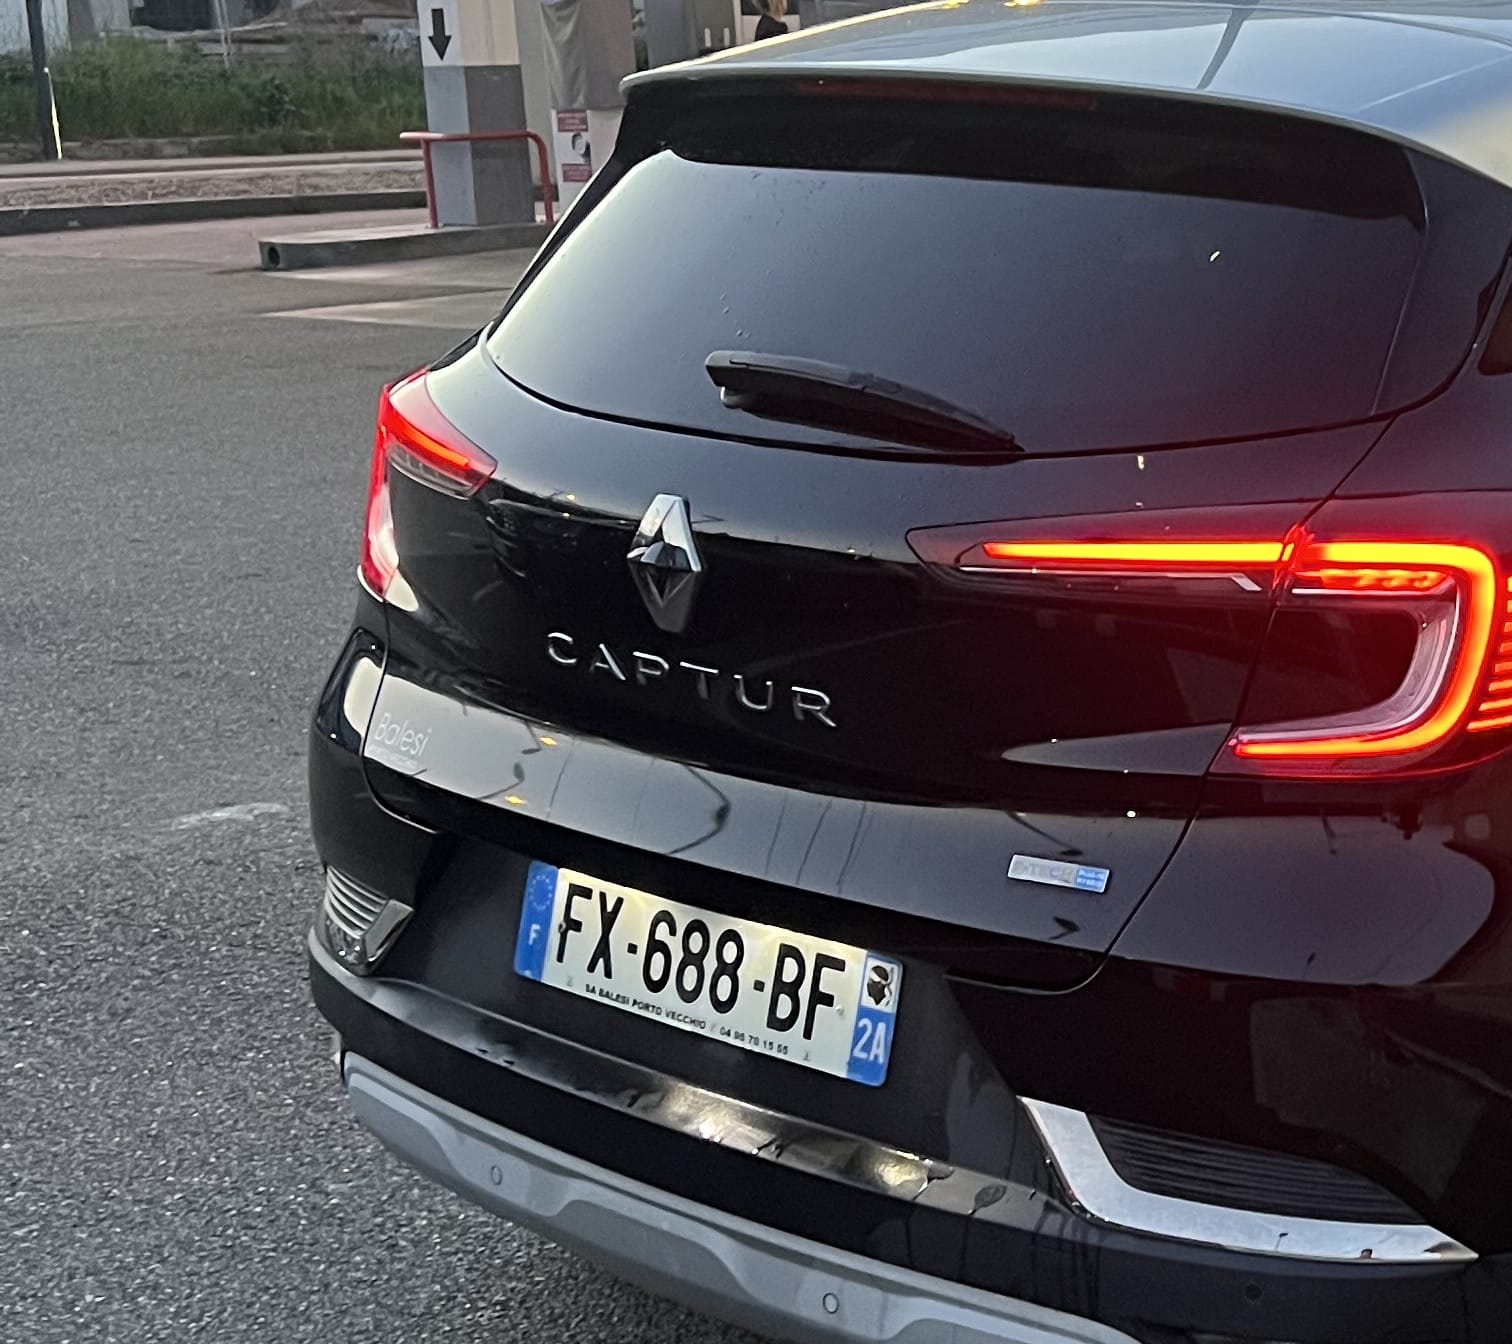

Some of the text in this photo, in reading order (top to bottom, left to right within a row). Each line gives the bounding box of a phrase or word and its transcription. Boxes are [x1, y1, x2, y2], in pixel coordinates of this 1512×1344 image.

[548, 631, 837, 728] CAPTUR
[374, 712, 433, 757] Balesi
[528, 924, 538, 945] F
[556, 882, 847, 1041] FX-688-BF
[598, 987, 630, 1006] BALESI
[631, 999, 662, 1016] PORTO
[664, 1010, 706, 1030] VECCHIO
[853, 1018, 886, 1064] 2A
